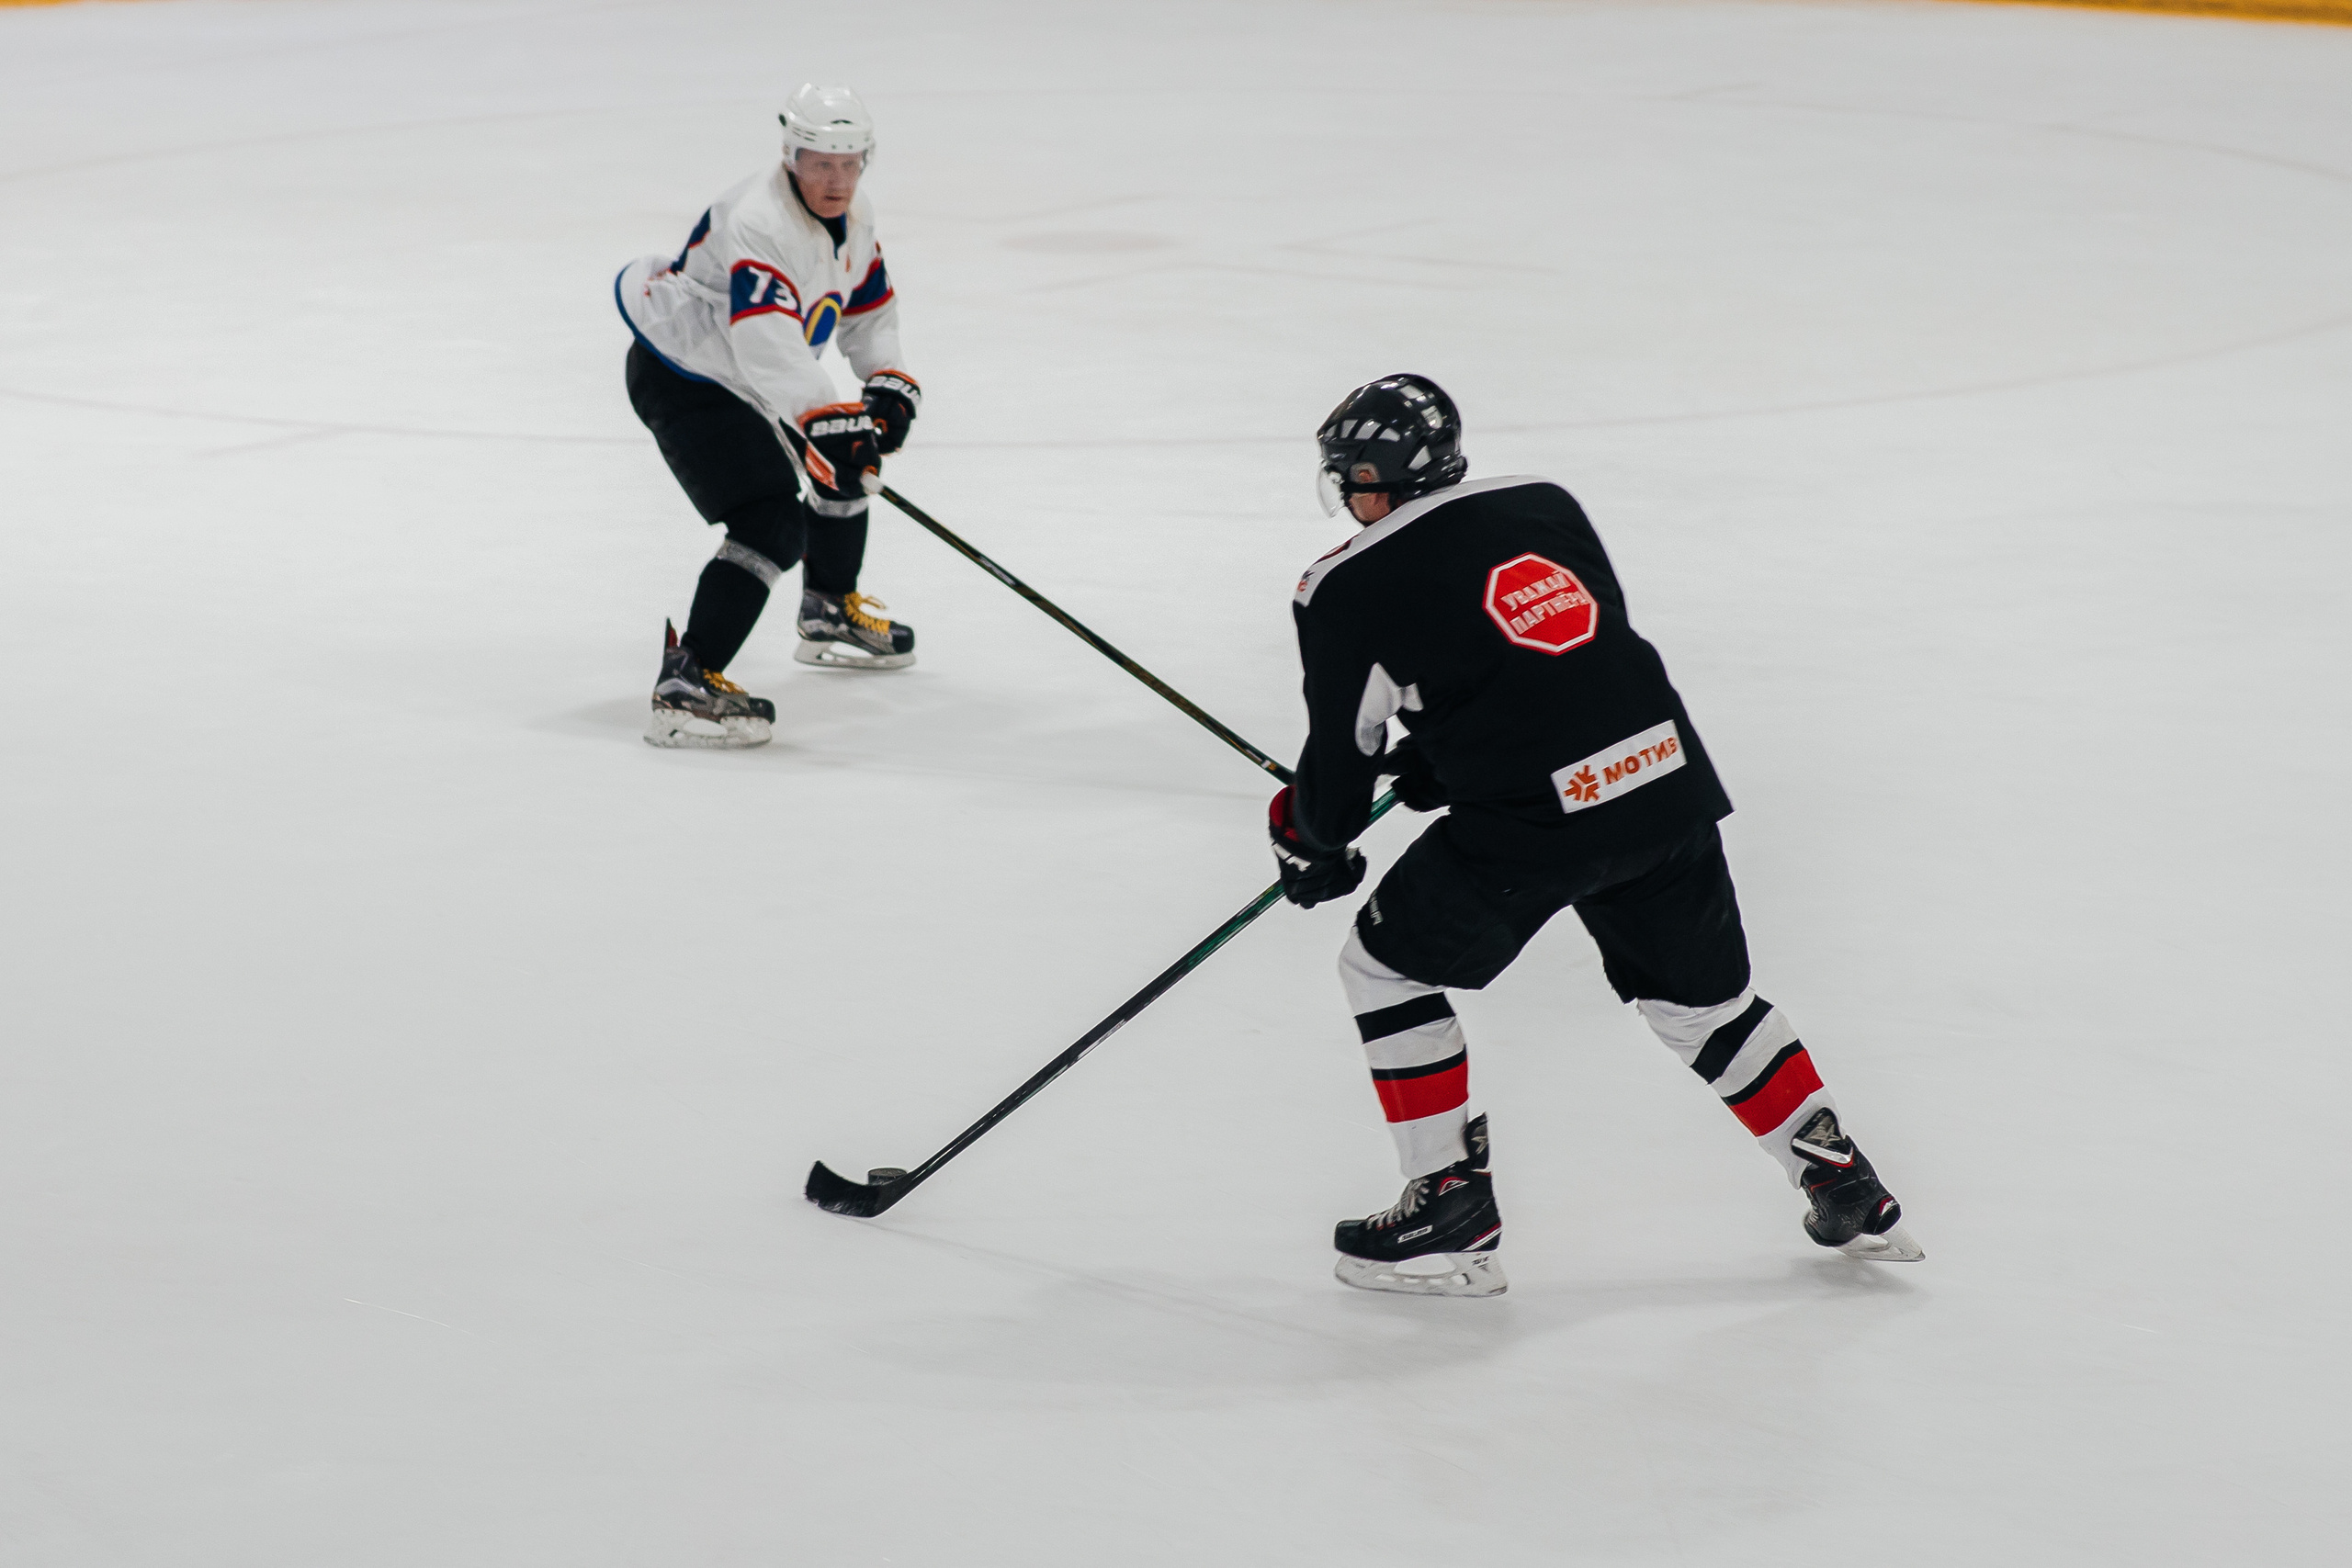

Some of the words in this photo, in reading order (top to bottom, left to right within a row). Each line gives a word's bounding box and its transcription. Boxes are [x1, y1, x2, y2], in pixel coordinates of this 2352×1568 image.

[748, 265, 798, 310] 73
[866, 375, 922, 405] BAU
[810, 415, 874, 437] BAU
[1500, 570, 1571, 612] УВАЖАЙ
[1601, 737, 1679, 785] МОТИВ
